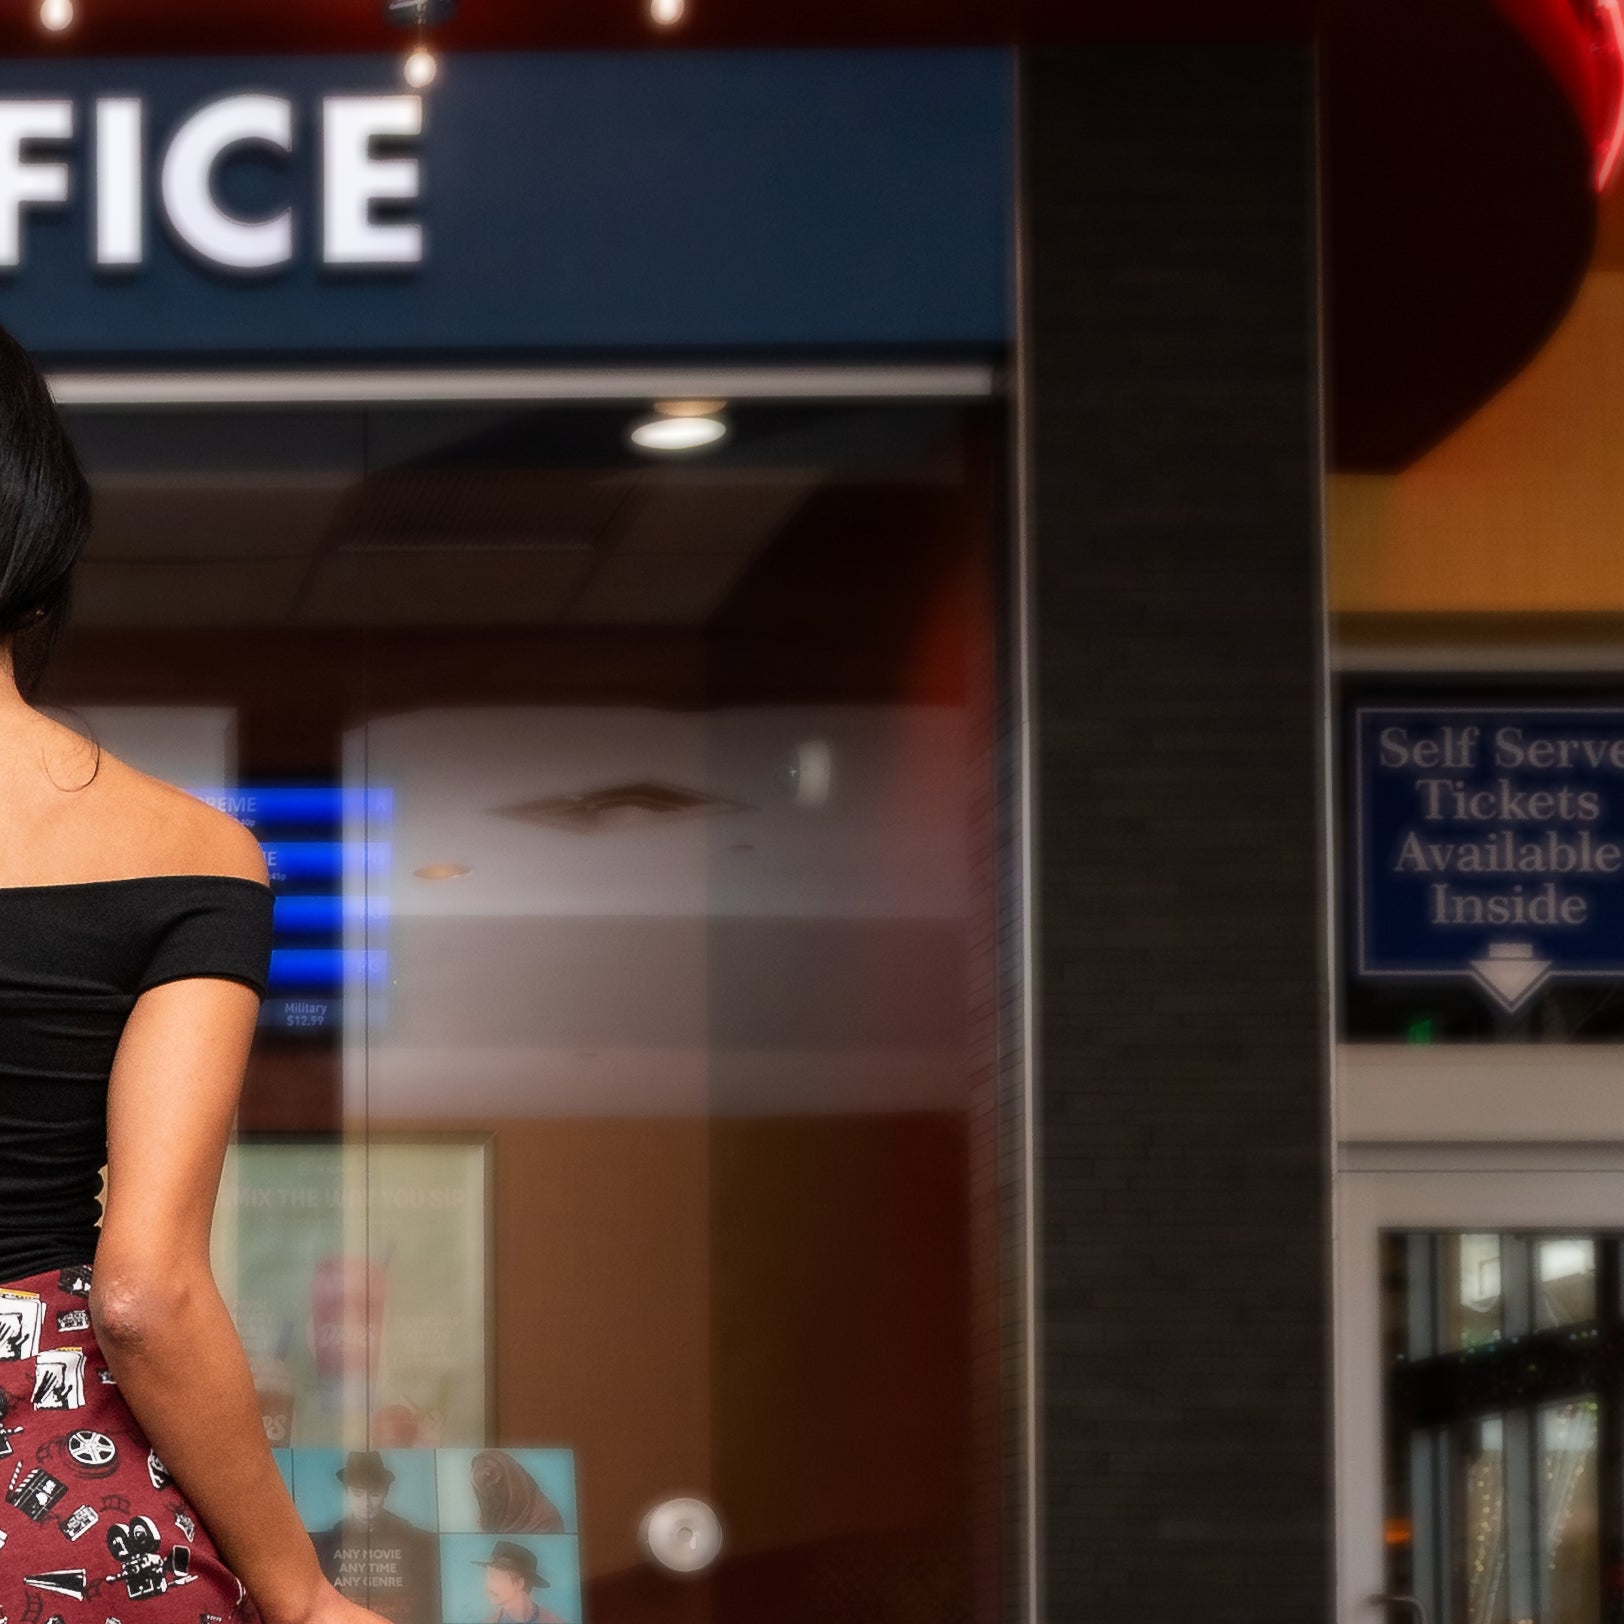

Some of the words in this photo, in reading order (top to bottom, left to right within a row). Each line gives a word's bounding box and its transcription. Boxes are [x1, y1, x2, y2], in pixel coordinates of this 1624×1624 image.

[1379, 727, 1481, 768] Self
[1495, 728, 1624, 768] Serve
[1416, 778, 1601, 820] Tickets
[1394, 830, 1623, 873] Available
[1432, 882, 1588, 924] Inside
[285, 1003, 327, 1016] Military
[287, 1015, 324, 1026] $12.99
[333, 1549, 365, 1560] ANY
[339, 1562, 367, 1573] ANY
[369, 1562, 397, 1573] TIME
[333, 1576, 362, 1588] ANY
[363, 1576, 404, 1588] GENRE
